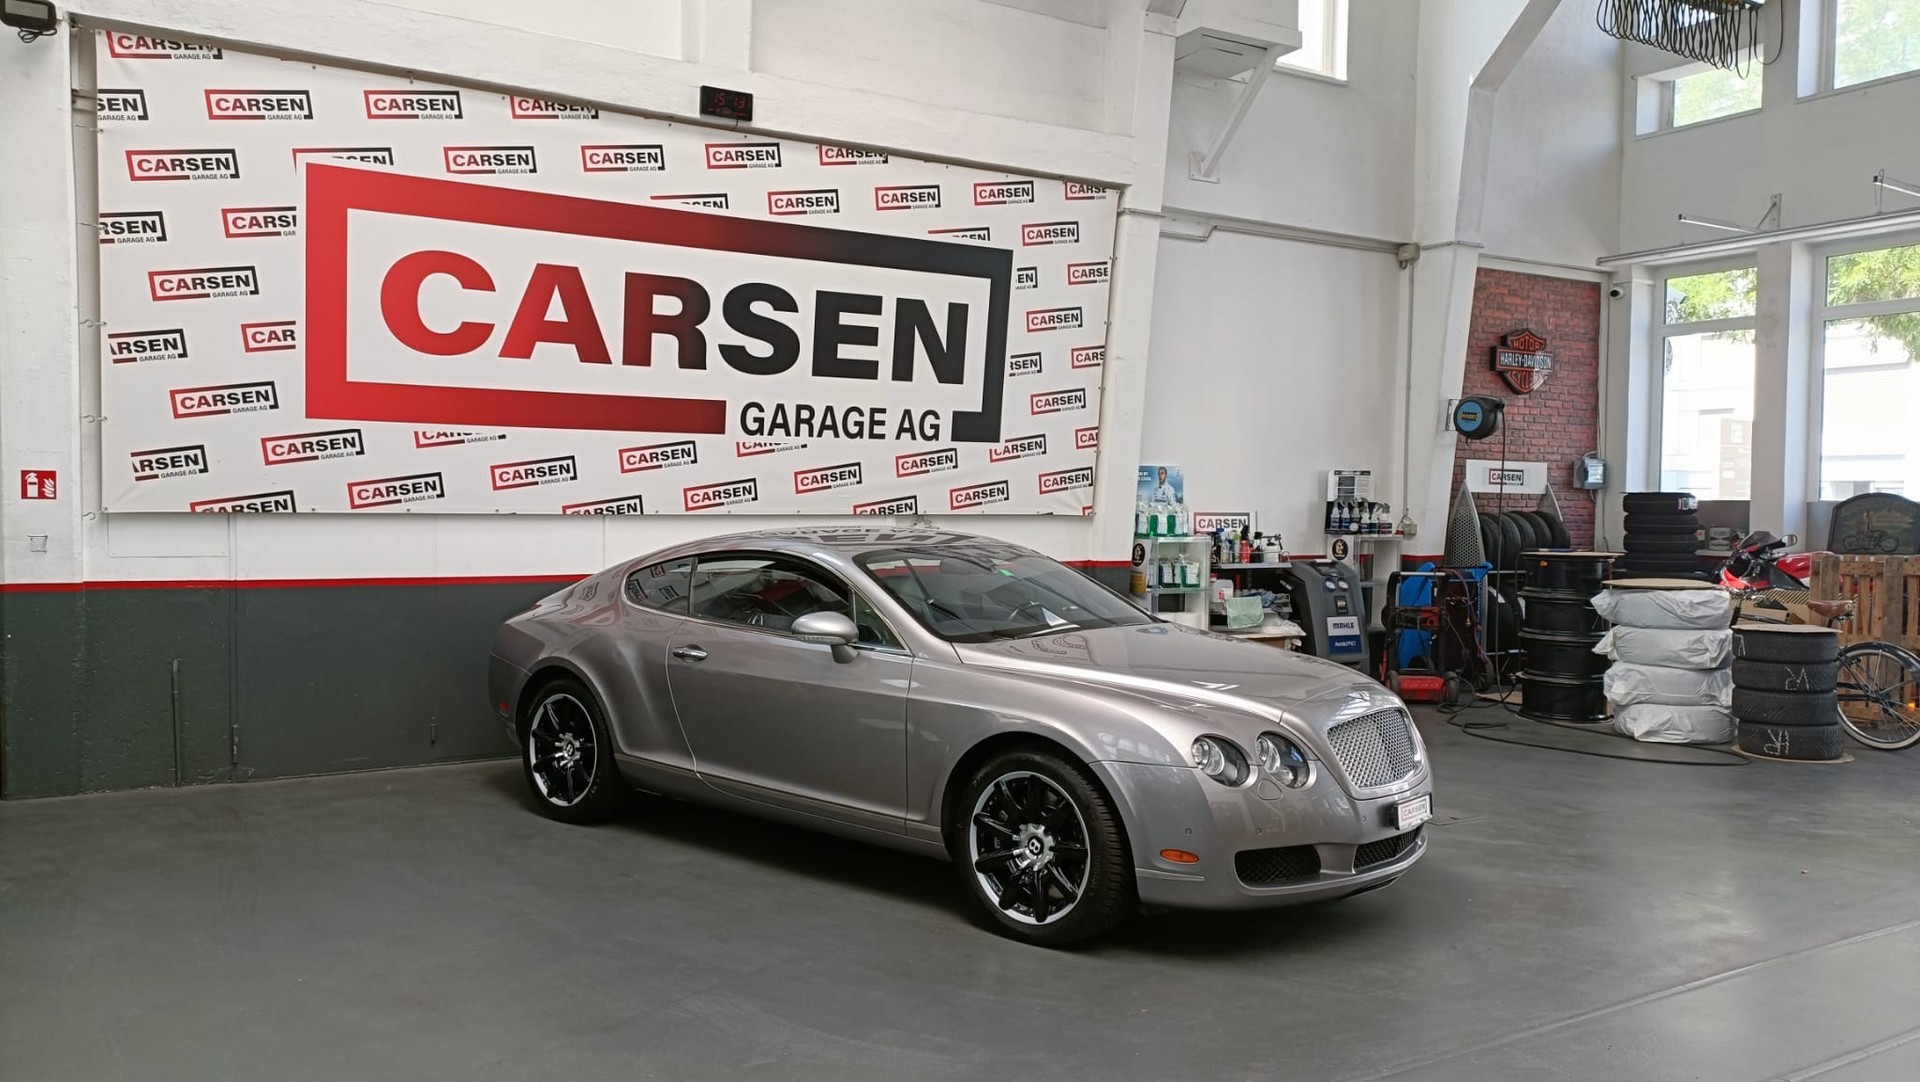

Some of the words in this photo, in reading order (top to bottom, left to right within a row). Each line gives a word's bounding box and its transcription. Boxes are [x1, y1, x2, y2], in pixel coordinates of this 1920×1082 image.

[216, 98, 304, 111] CARSEN
[374, 98, 455, 111] CARSEN
[453, 154, 529, 166] CARSEN
[589, 152, 658, 164] CARSEN
[713, 150, 776, 162] CARSEN
[137, 158, 230, 172] CARSEN
[881, 192, 936, 204] CARSEN
[979, 187, 1030, 199] CARSEN
[774, 196, 834, 209] CARSEN
[1027, 228, 1075, 240] CARSEN
[159, 275, 250, 292] CARSEN
[381, 250, 969, 385] CARSEN
[1031, 313, 1078, 326] CARSEN
[252, 330, 296, 344] CAR
[1513, 336, 1541, 350] MOTOR
[1500, 352, 1551, 369] HARLEY-DAVIDSON
[180, 390, 270, 409] CARSEN
[1036, 394, 1082, 408] CARSEN
[232, 405, 257, 413] GARAGE
[740, 401, 887, 440] GARAGE
[895, 409, 940, 442] AG
[272, 437, 356, 456] CARSEN
[626, 448, 691, 465] CARSEN
[901, 454, 953, 470] CARSEN
[499, 463, 570, 482] CARSEN
[800, 469, 857, 486] CARSEN
[1492, 473, 1522, 481] CARSEN
[1044, 473, 1089, 488] CARSEN
[357, 480, 437, 500] CARSEN
[690, 485, 752, 504] CARSEN
[955, 486, 1004, 503] CARSEN
[403, 495, 425, 503] GARAGE
[1198, 518, 1246, 529] CARSEN
